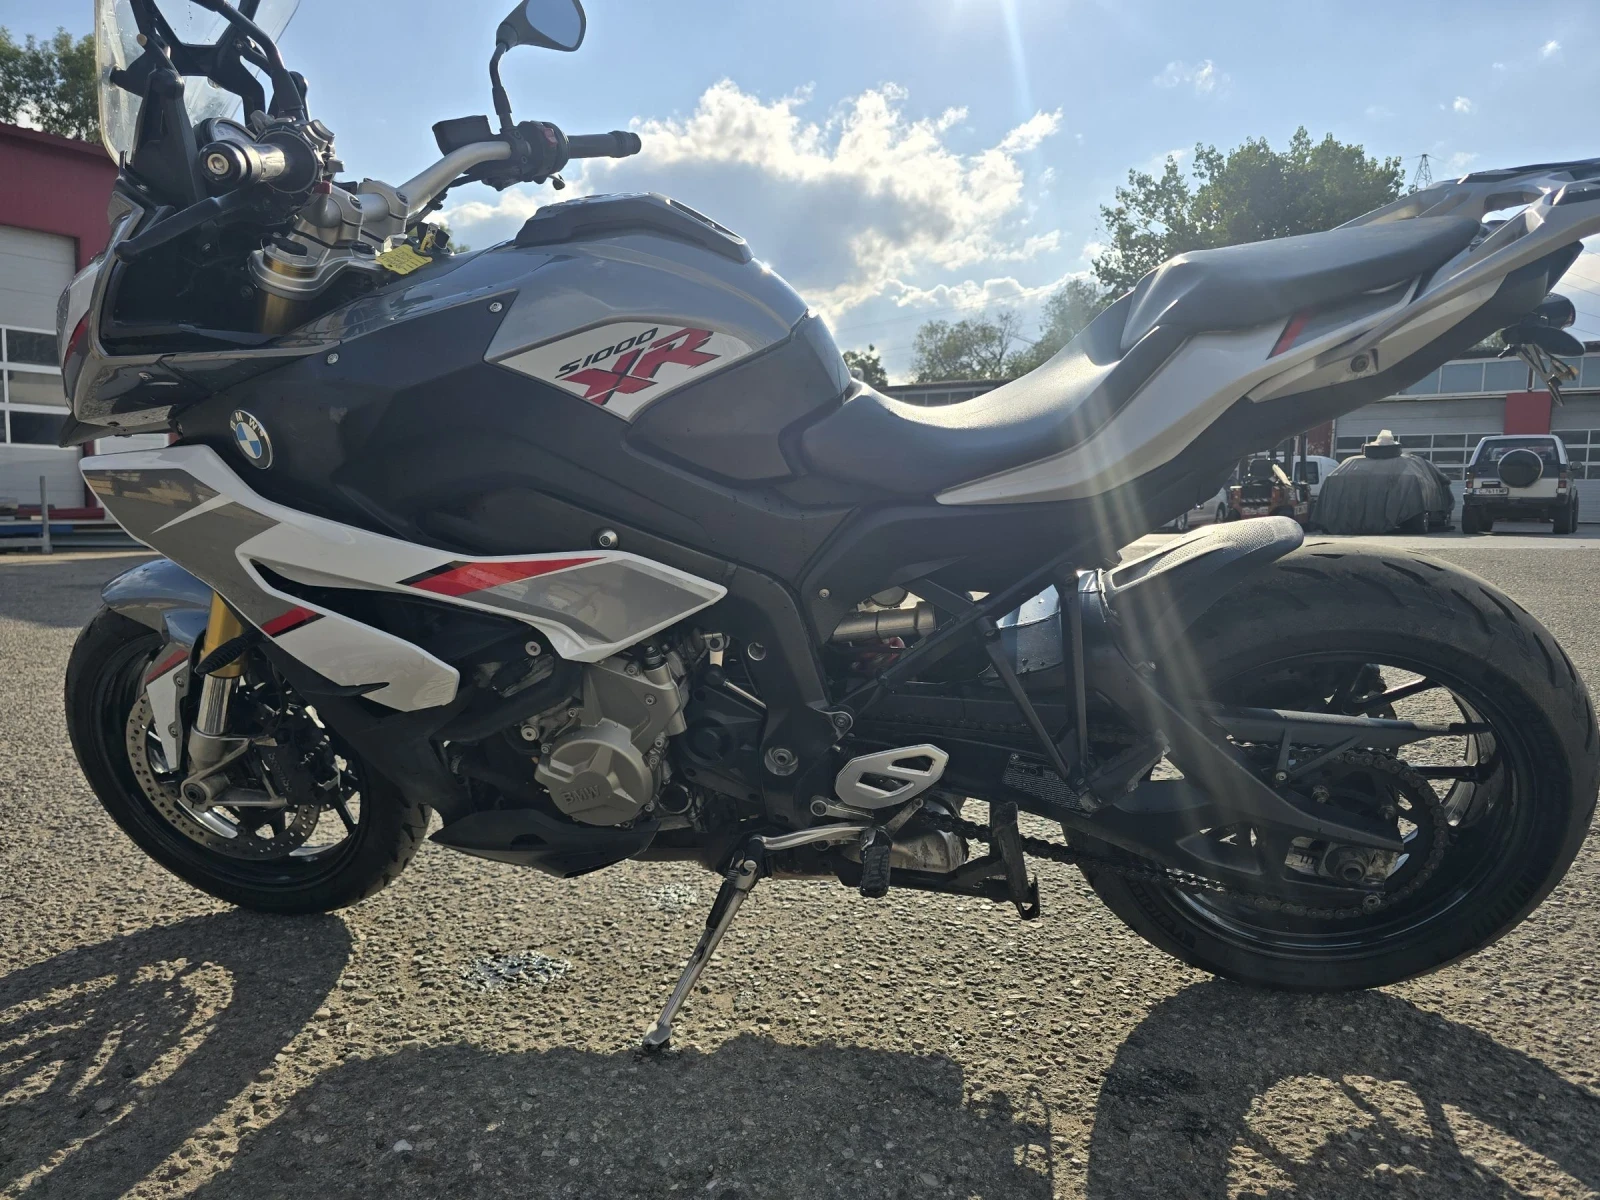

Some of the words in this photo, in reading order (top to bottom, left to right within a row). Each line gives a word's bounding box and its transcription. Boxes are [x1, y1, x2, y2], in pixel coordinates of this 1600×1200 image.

[555, 327, 659, 379] S1000
[561, 327, 722, 406] XR
[229, 411, 259, 432] BMW
[561, 784, 601, 805] BMW
